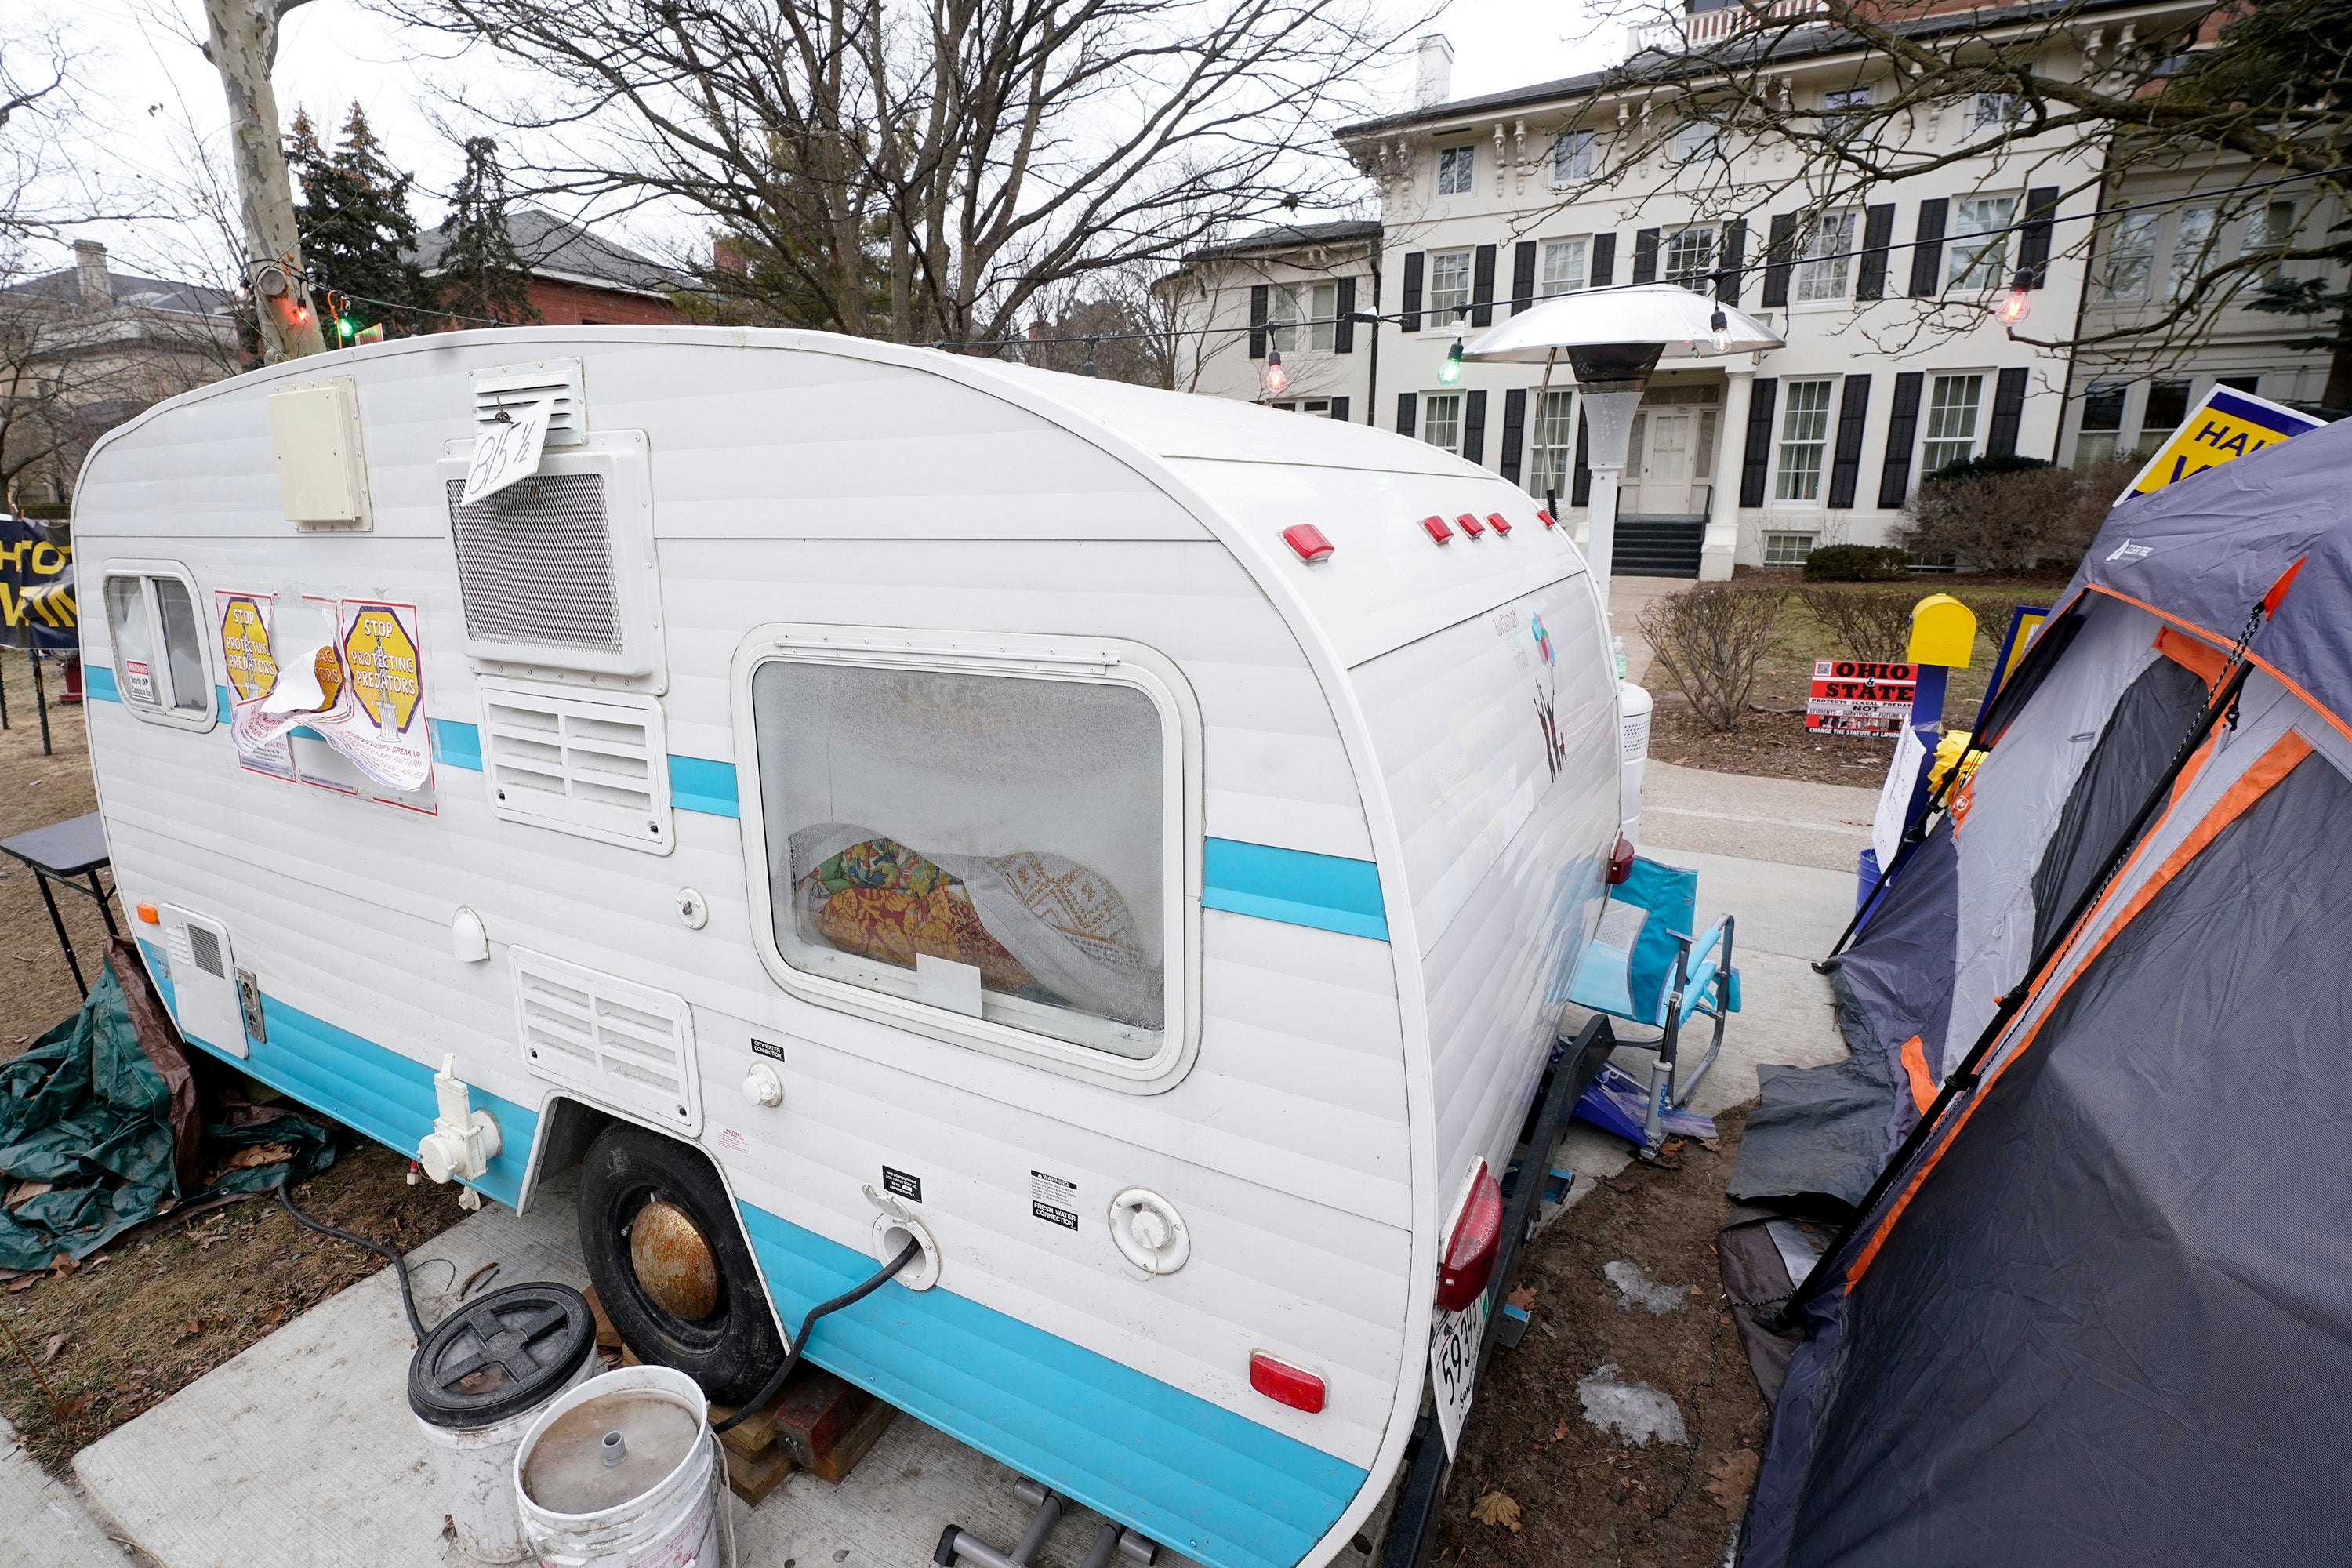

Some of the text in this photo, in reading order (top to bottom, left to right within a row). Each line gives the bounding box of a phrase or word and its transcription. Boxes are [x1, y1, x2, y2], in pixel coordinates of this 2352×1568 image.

[2194, 420, 2273, 457] HAI
[233, 608, 255, 626] STOP
[364, 619, 393, 638] STOP
[226, 636, 271, 656] PROTECTING
[229, 654, 275, 676] PREDATORS
[350, 650, 414, 674] PROTECTING
[1836, 662, 1910, 680] OHIO
[355, 670, 416, 695] PREDATORS
[1867, 677, 1875, 686] &
[1825, 683, 1914, 701] STATE
[345, 730, 390, 752] SURVIVORS
[391, 746, 412, 757] SPEAK
[394, 756, 422, 768] PATTERN
[400, 768, 426, 779] ABUSE
[1044, 1174, 1069, 1187] WARNING
[1035, 1202, 1076, 1221] FRESH WATER
[1036, 1209, 1074, 1226] CONNECTION
